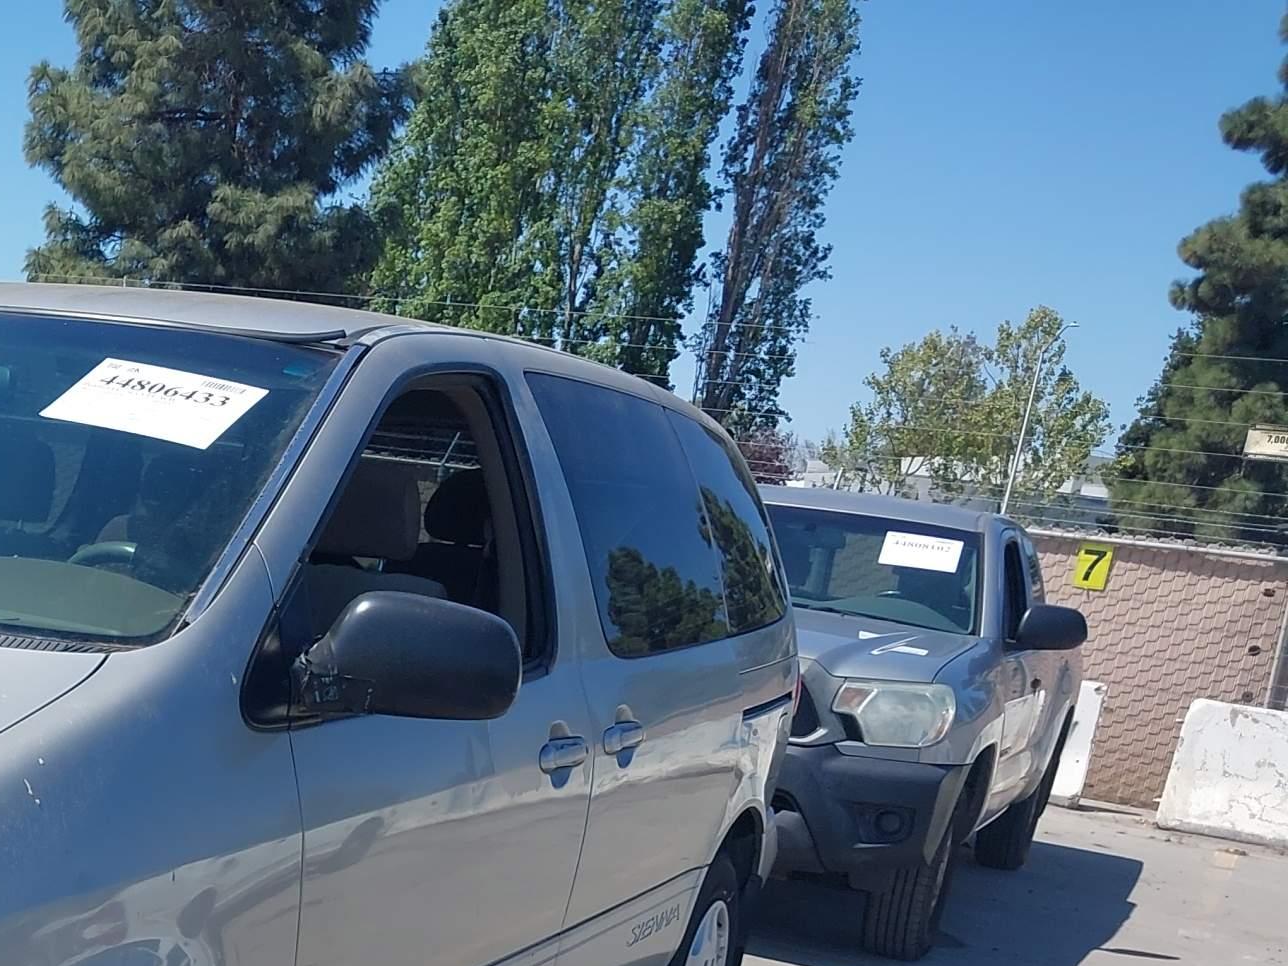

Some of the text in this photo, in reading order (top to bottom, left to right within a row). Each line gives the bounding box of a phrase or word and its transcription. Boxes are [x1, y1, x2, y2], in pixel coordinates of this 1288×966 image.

[99, 374, 231, 407] 44806433
[1082, 549, 1108, 582] 7
[626, 903, 681, 948] SIENNA
